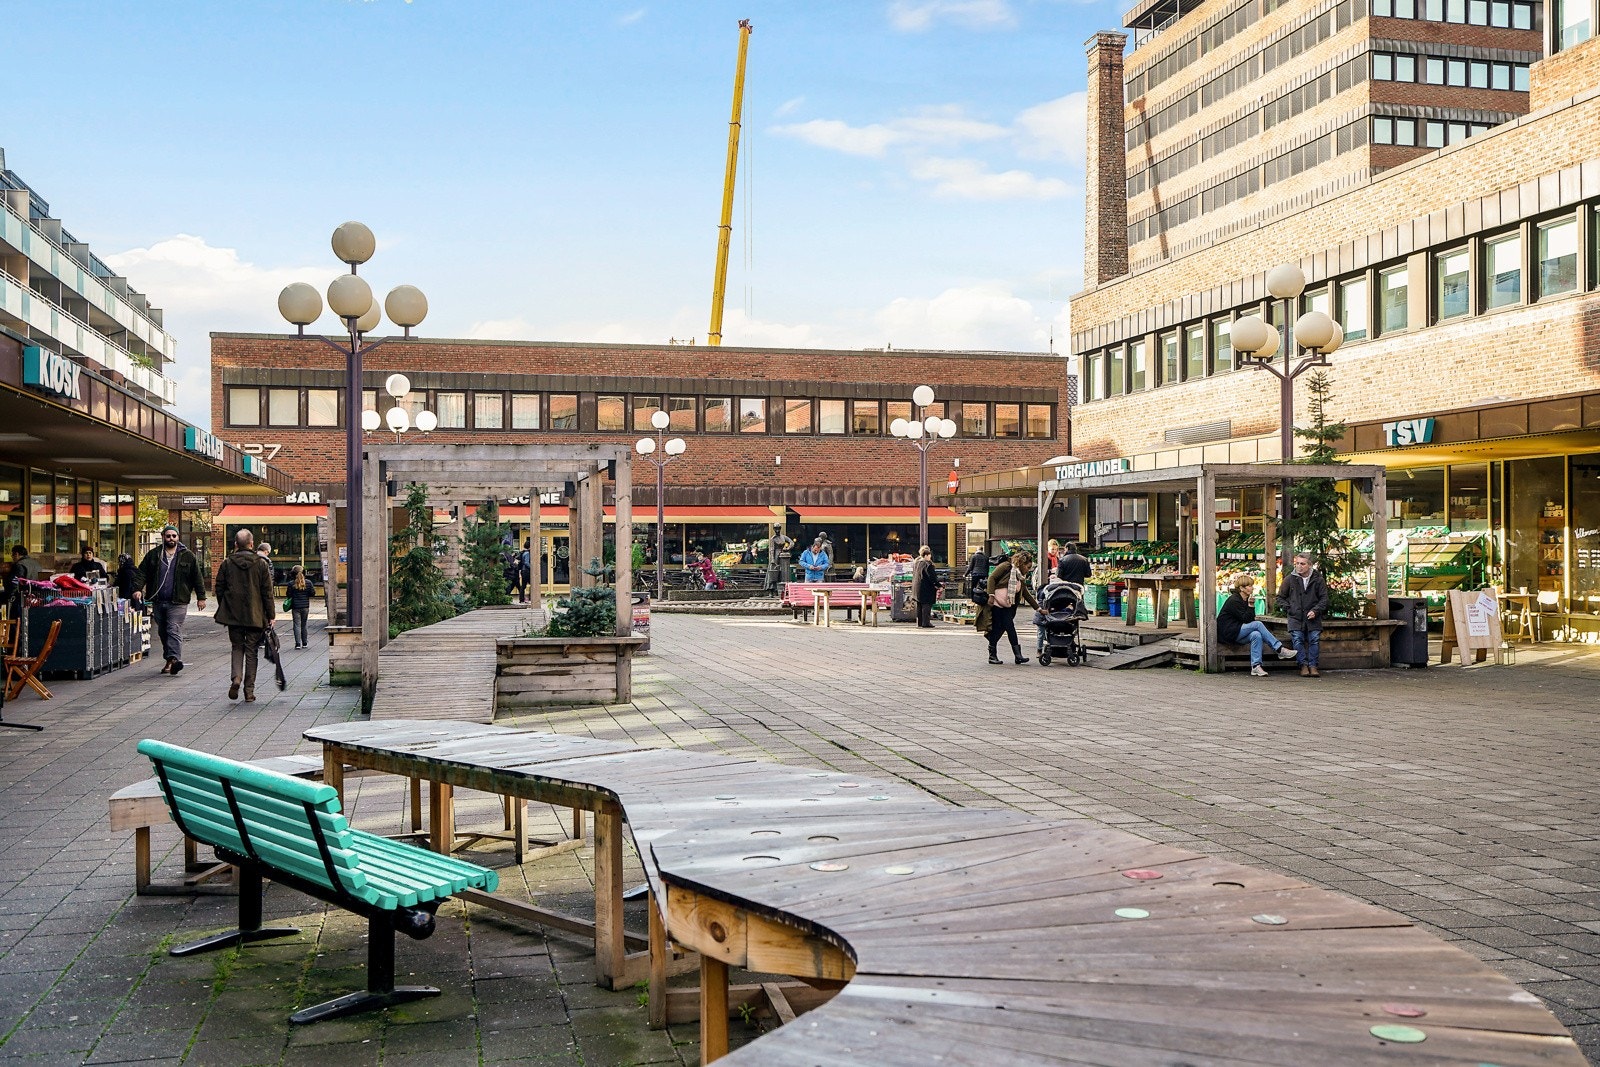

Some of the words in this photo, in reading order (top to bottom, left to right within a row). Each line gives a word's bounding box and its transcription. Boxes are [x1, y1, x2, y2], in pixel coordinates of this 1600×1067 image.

[40, 347, 81, 400] KIOSK
[1383, 418, 1428, 446] TSV
[237, 443, 282, 460] 27
[1055, 458, 1125, 480] TORGHANDEL
[286, 491, 321, 504] BAR
[507, 493, 560, 504] SCNE
